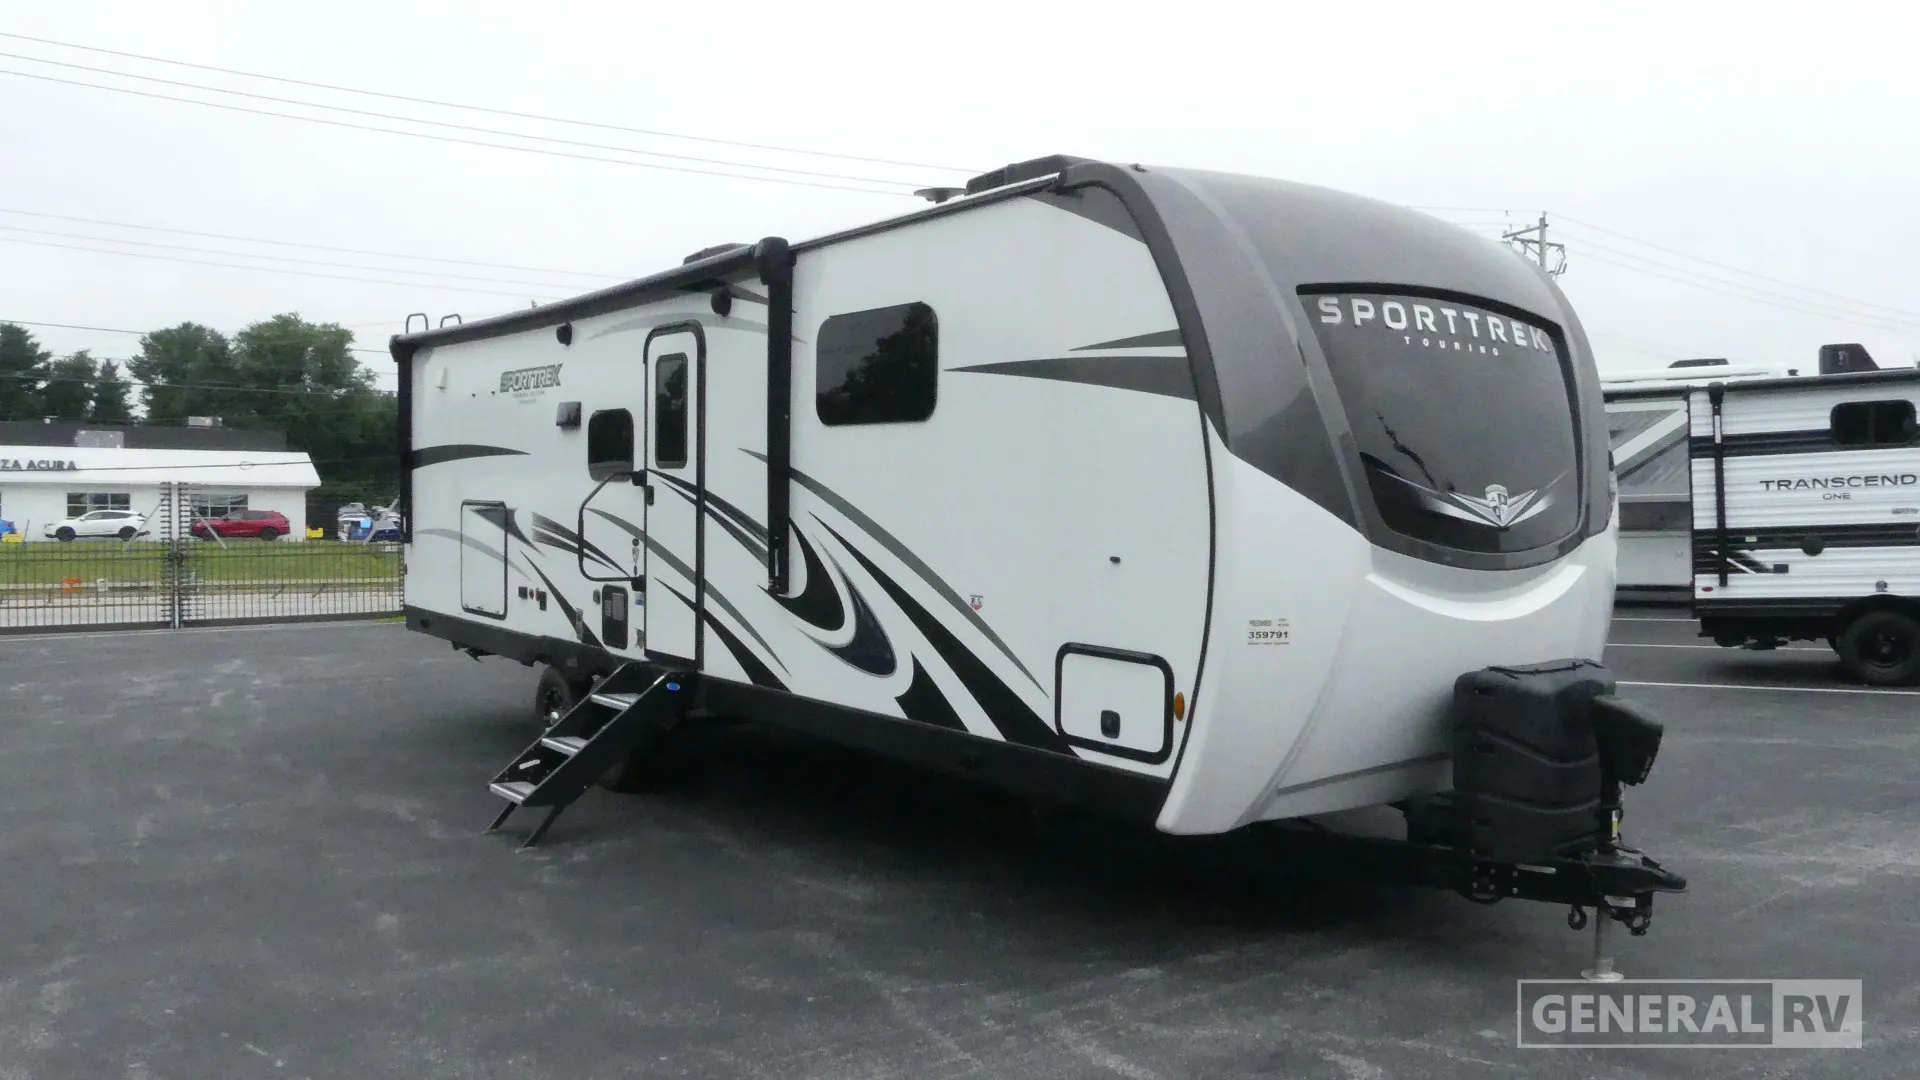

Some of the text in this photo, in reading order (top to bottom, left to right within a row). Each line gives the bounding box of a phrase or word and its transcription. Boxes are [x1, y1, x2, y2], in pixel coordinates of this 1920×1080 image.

[1317, 296, 1550, 352] SPORTTREK
[1403, 335, 1500, 356] TOURING
[500, 363, 563, 393] SPORTTREK
[0, 458, 77, 471] ZA ACURA
[1759, 474, 1918, 491] TRANSCEND
[1822, 492, 1851, 501] ONE
[1247, 630, 1289, 640] 359791
